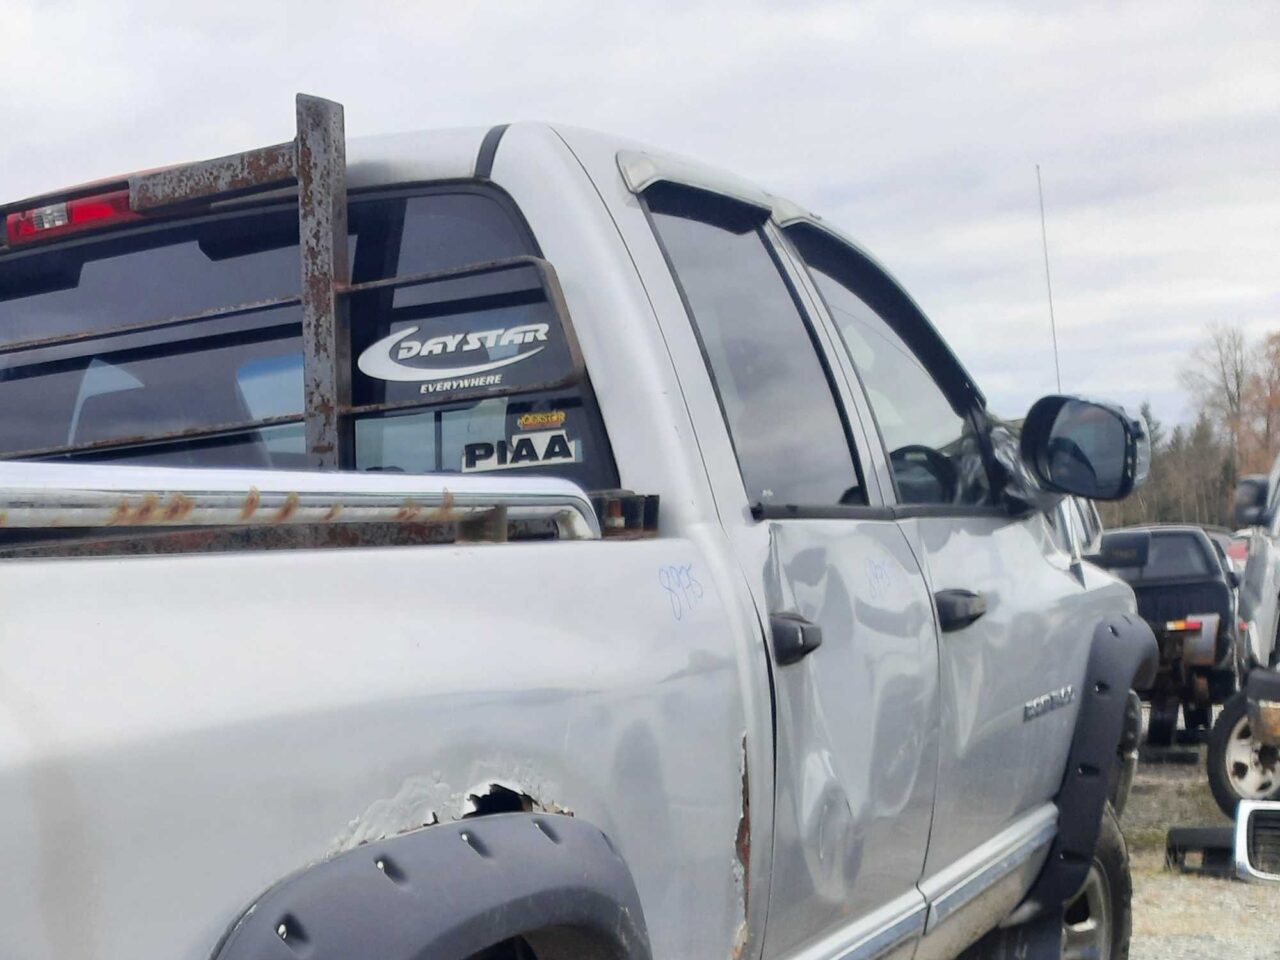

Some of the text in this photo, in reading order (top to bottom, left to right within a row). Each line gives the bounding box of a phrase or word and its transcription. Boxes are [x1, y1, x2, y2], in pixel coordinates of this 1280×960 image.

[398, 323, 550, 360] DAYSTAR
[419, 374, 503, 395] EVERYWHERE
[464, 434, 573, 468] PIAA
